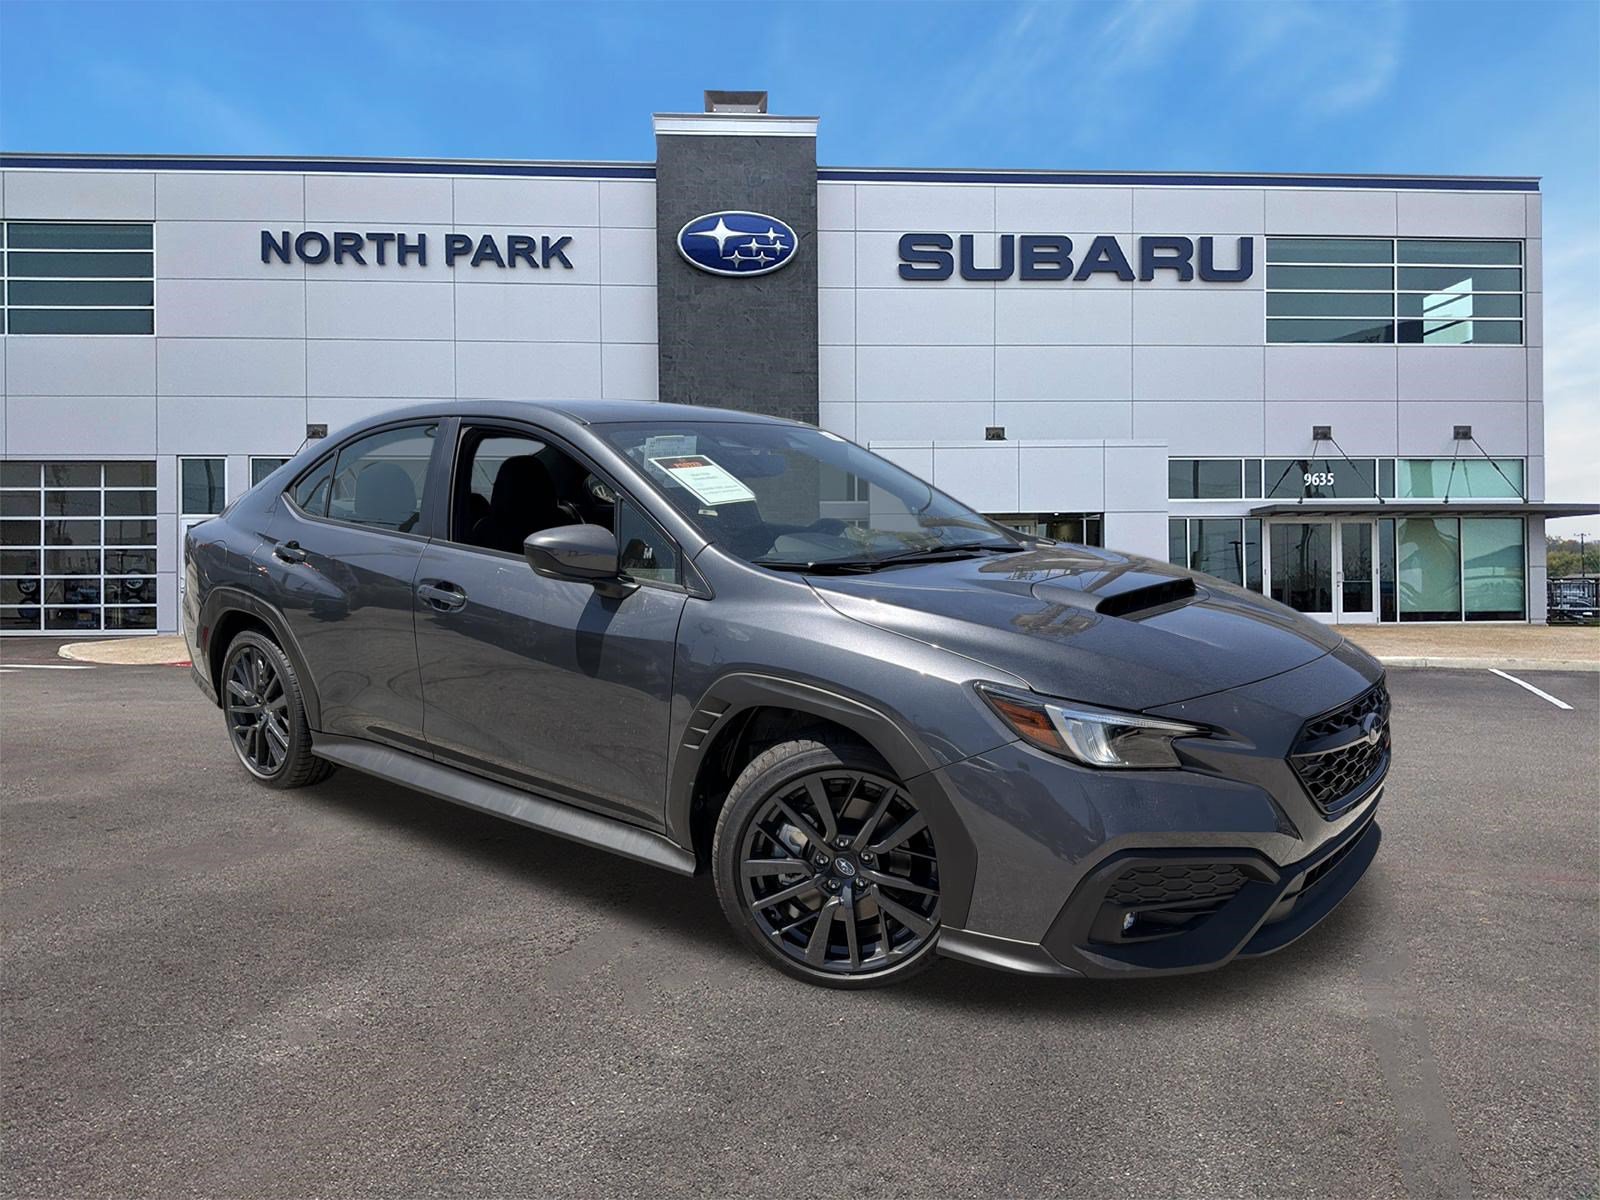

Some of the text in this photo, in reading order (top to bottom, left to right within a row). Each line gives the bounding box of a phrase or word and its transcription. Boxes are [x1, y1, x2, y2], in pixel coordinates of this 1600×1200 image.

[261, 231, 574, 269] NORTH PARK
[898, 233, 1254, 282] SUBARU
[1304, 472, 1335, 486] 9635
